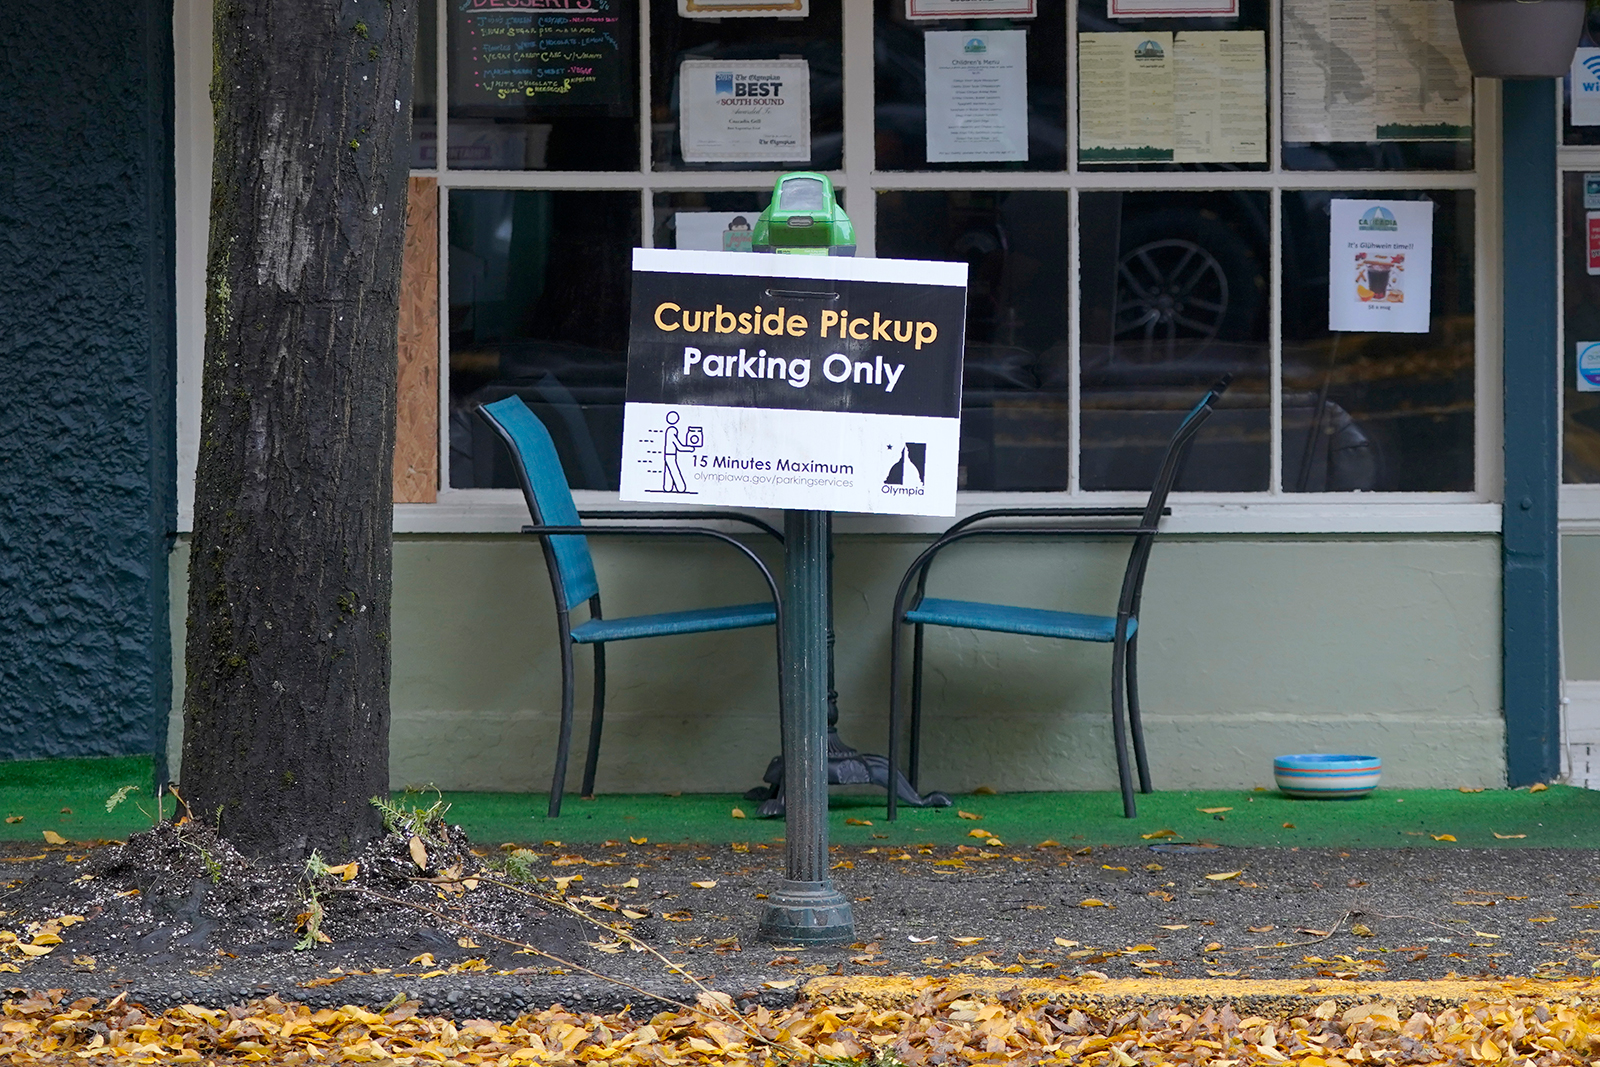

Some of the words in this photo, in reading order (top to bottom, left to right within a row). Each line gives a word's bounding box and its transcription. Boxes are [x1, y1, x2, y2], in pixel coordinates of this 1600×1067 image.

[748, 74, 780, 82] Olympian
[735, 82, 783, 97] BEST
[1360, 241, 1392, 250] Glühwein
[654, 302, 809, 338] Curbside
[820, 309, 938, 350] Pickup
[683, 347, 811, 388] Parking
[822, 353, 905, 392] Only
[692, 454, 708, 468] 15
[712, 455, 772, 471] Minutes
[776, 458, 854, 475] Maximum
[694, 472, 854, 488] olympiawa.gov/parkingservices
[881, 484, 925, 497] Olympia
